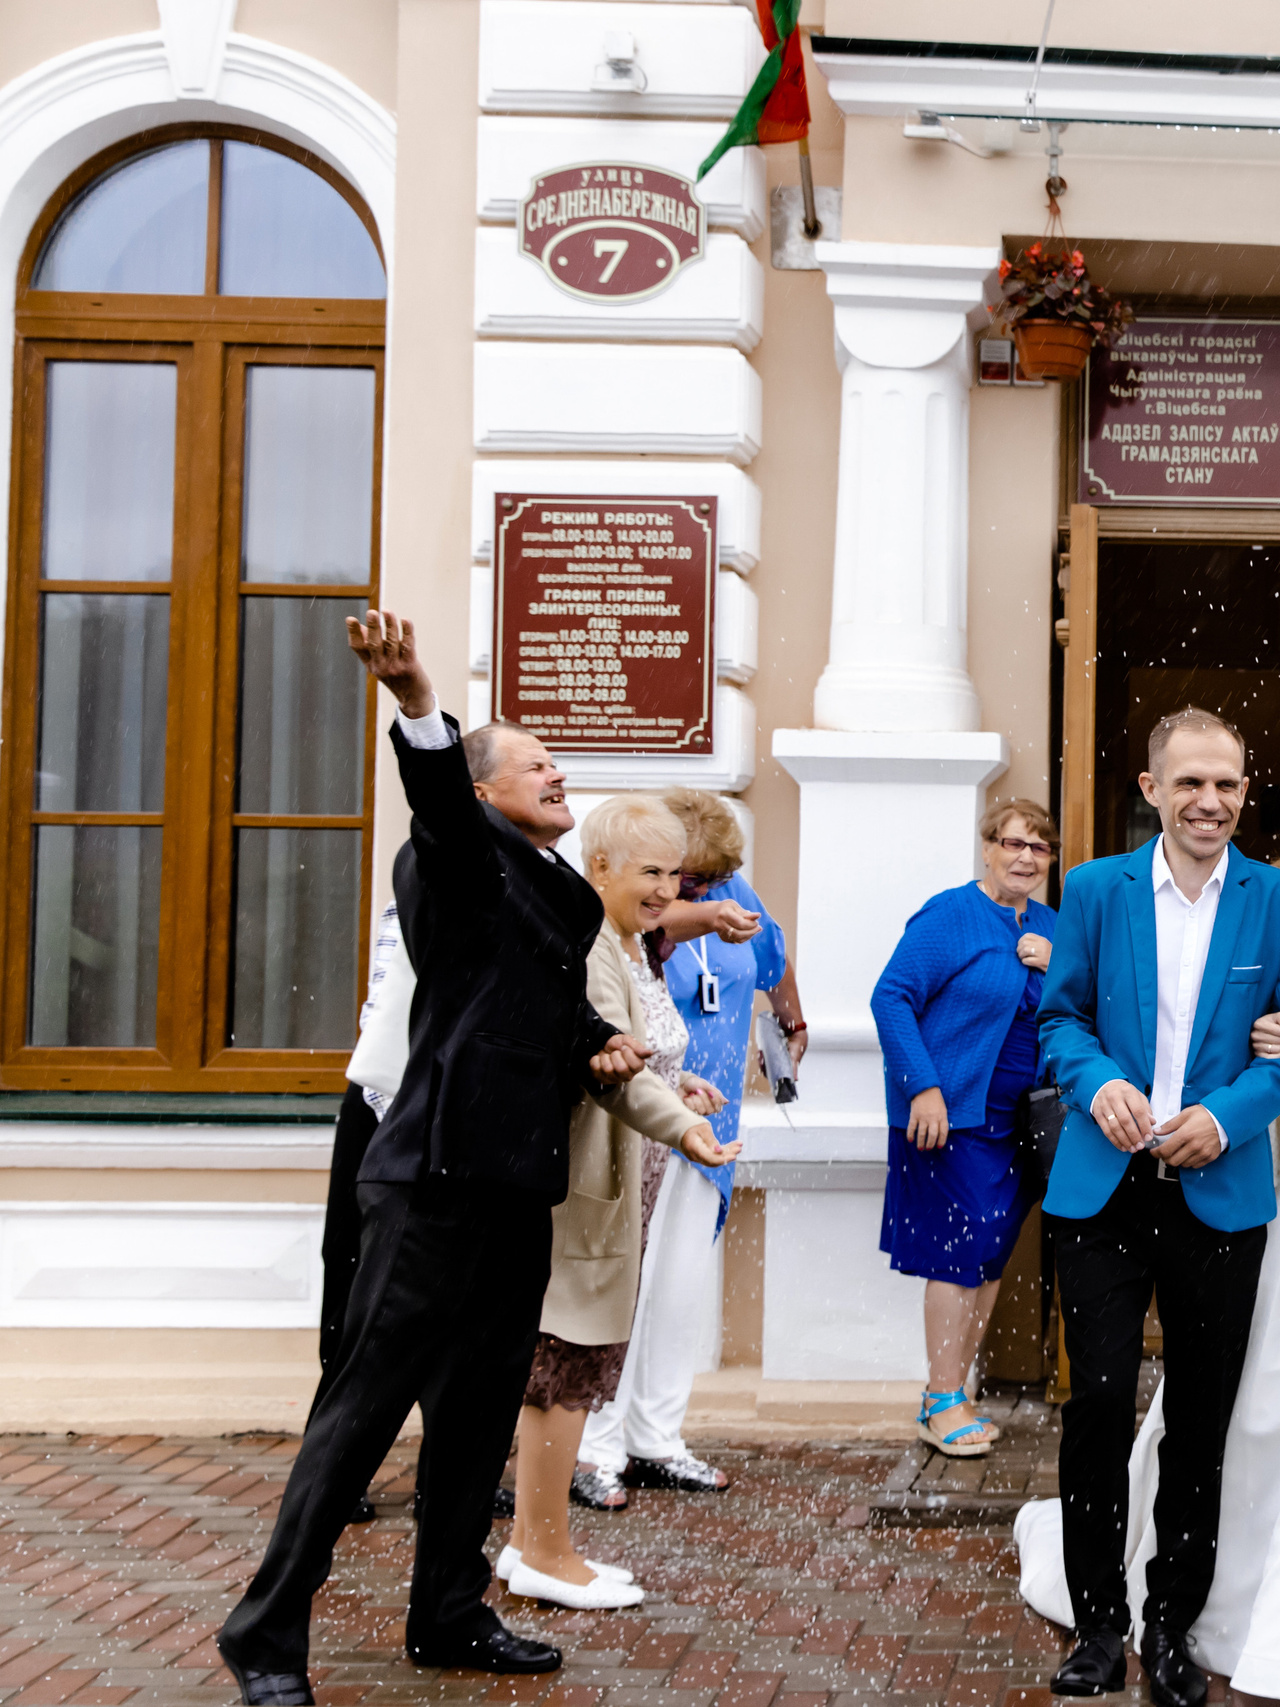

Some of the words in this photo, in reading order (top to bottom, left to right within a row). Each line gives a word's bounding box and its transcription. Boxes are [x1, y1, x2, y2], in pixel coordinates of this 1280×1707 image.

[580, 169, 644, 187] улица
[526, 187, 697, 237] СРЕДНЕНАБЕРЕЖНАЯ
[593, 238, 629, 284] 7
[1190, 335, 1256, 349] гарадскі
[1110, 350, 1199, 365] выканаўчы
[1126, 369, 1246, 384] Адміністрацыя
[1109, 385, 1210, 400] Чыгуначнага
[1216, 386, 1263, 402] раёна
[1145, 402, 1226, 416] г.Віцебска
[1101, 424, 1161, 443] АДДЗЕЛ
[1169, 425, 1224, 442] ЗАПІСУ
[1231, 423, 1280, 443] АКТАЎ
[1121, 445, 1259, 465] ГРАМАДЗЯНСКАГА
[1165, 467, 1214, 484] СТАНУ
[541, 511, 598, 525] РЕЖИМ
[604, 512, 674, 526] РАБОТЫ:
[544, 588, 602, 602] ГРАФИК
[606, 587, 666, 602] ПРИЁМА
[528, 602, 681, 617] ЗАИНТЕРЕСОВАННЫХ
[587, 617, 622, 630] ЛИЦ:
[624, 630, 689, 644] 14.00-20.00
[620, 645, 681, 659] 14.00-17.00
